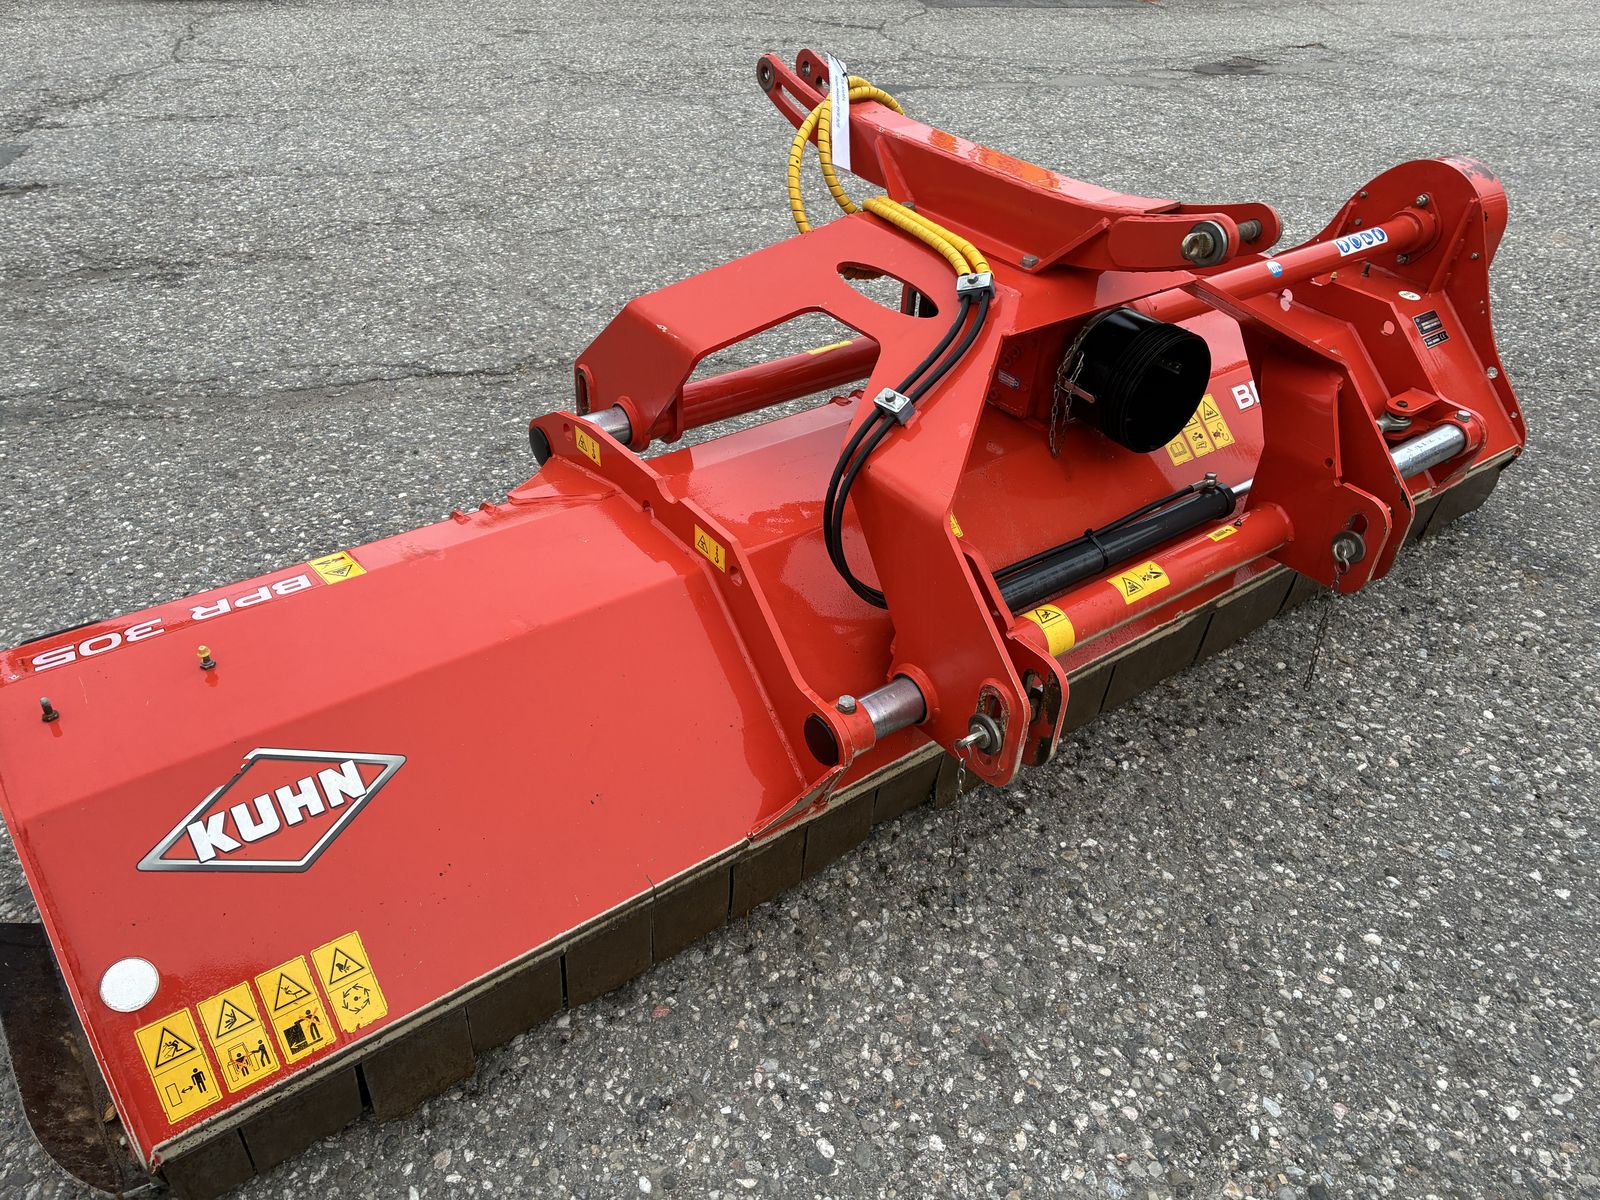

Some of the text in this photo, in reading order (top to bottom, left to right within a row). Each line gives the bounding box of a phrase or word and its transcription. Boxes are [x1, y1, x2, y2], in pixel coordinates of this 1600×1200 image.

[31, 574, 313, 672] BPR 305
[186, 760, 367, 863] KUHN
